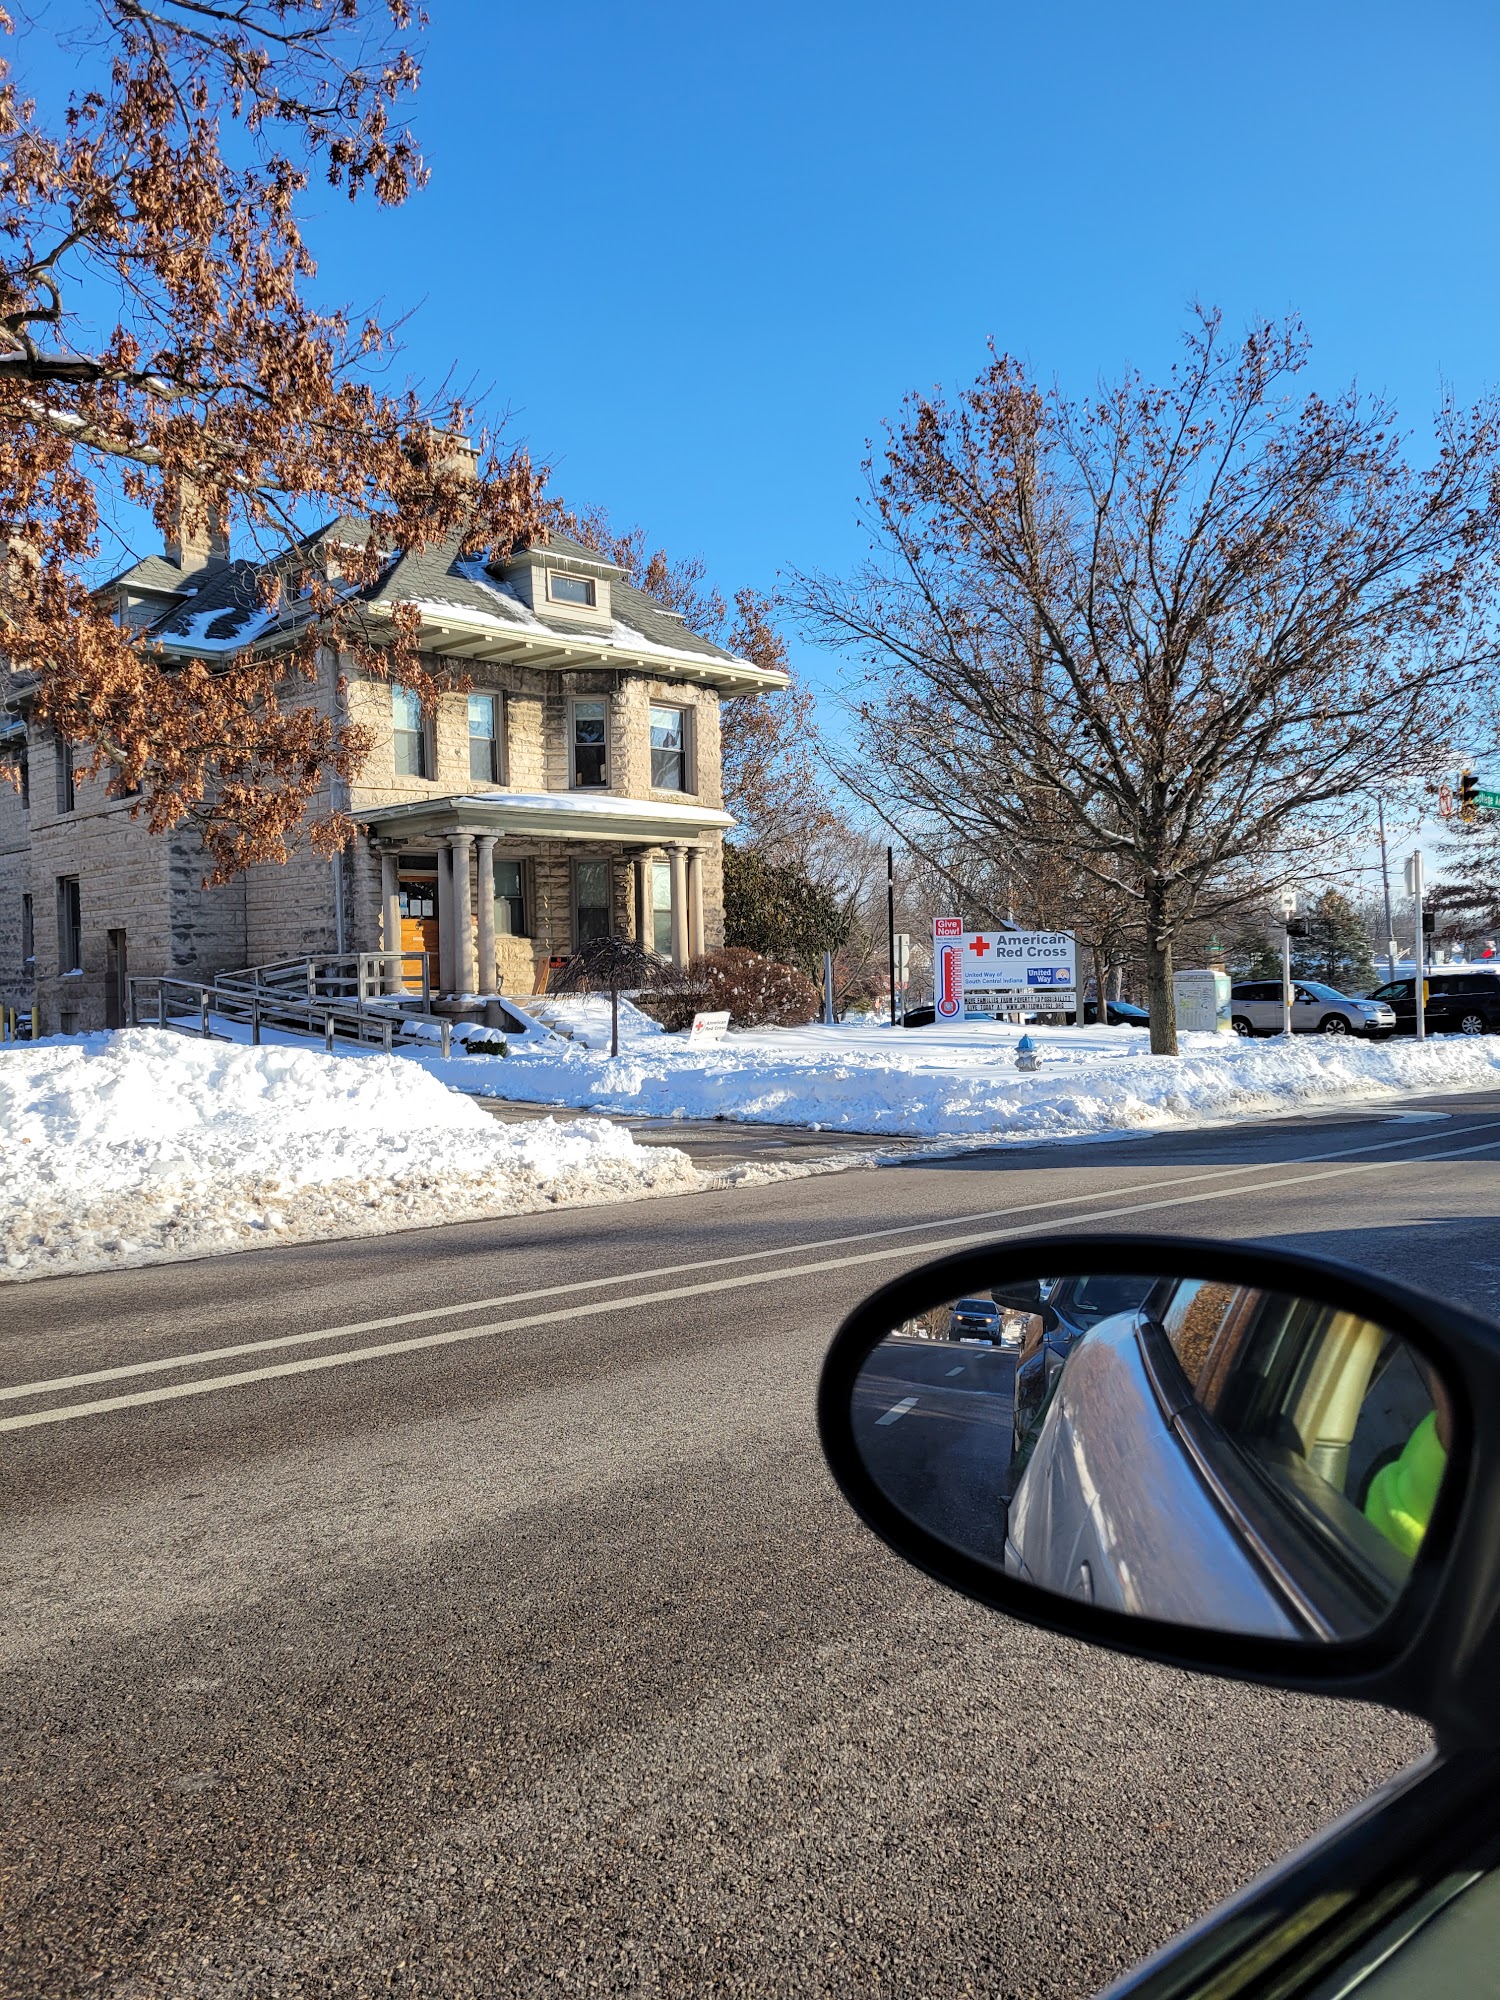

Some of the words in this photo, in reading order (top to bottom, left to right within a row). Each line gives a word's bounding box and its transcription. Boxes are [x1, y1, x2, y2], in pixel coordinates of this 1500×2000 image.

[938, 927, 960, 935] Now!
[997, 934, 1066, 945] American
[997, 946, 1023, 957] Red
[1027, 946, 1067, 957] Cross
[1037, 975, 1052, 983] Way
